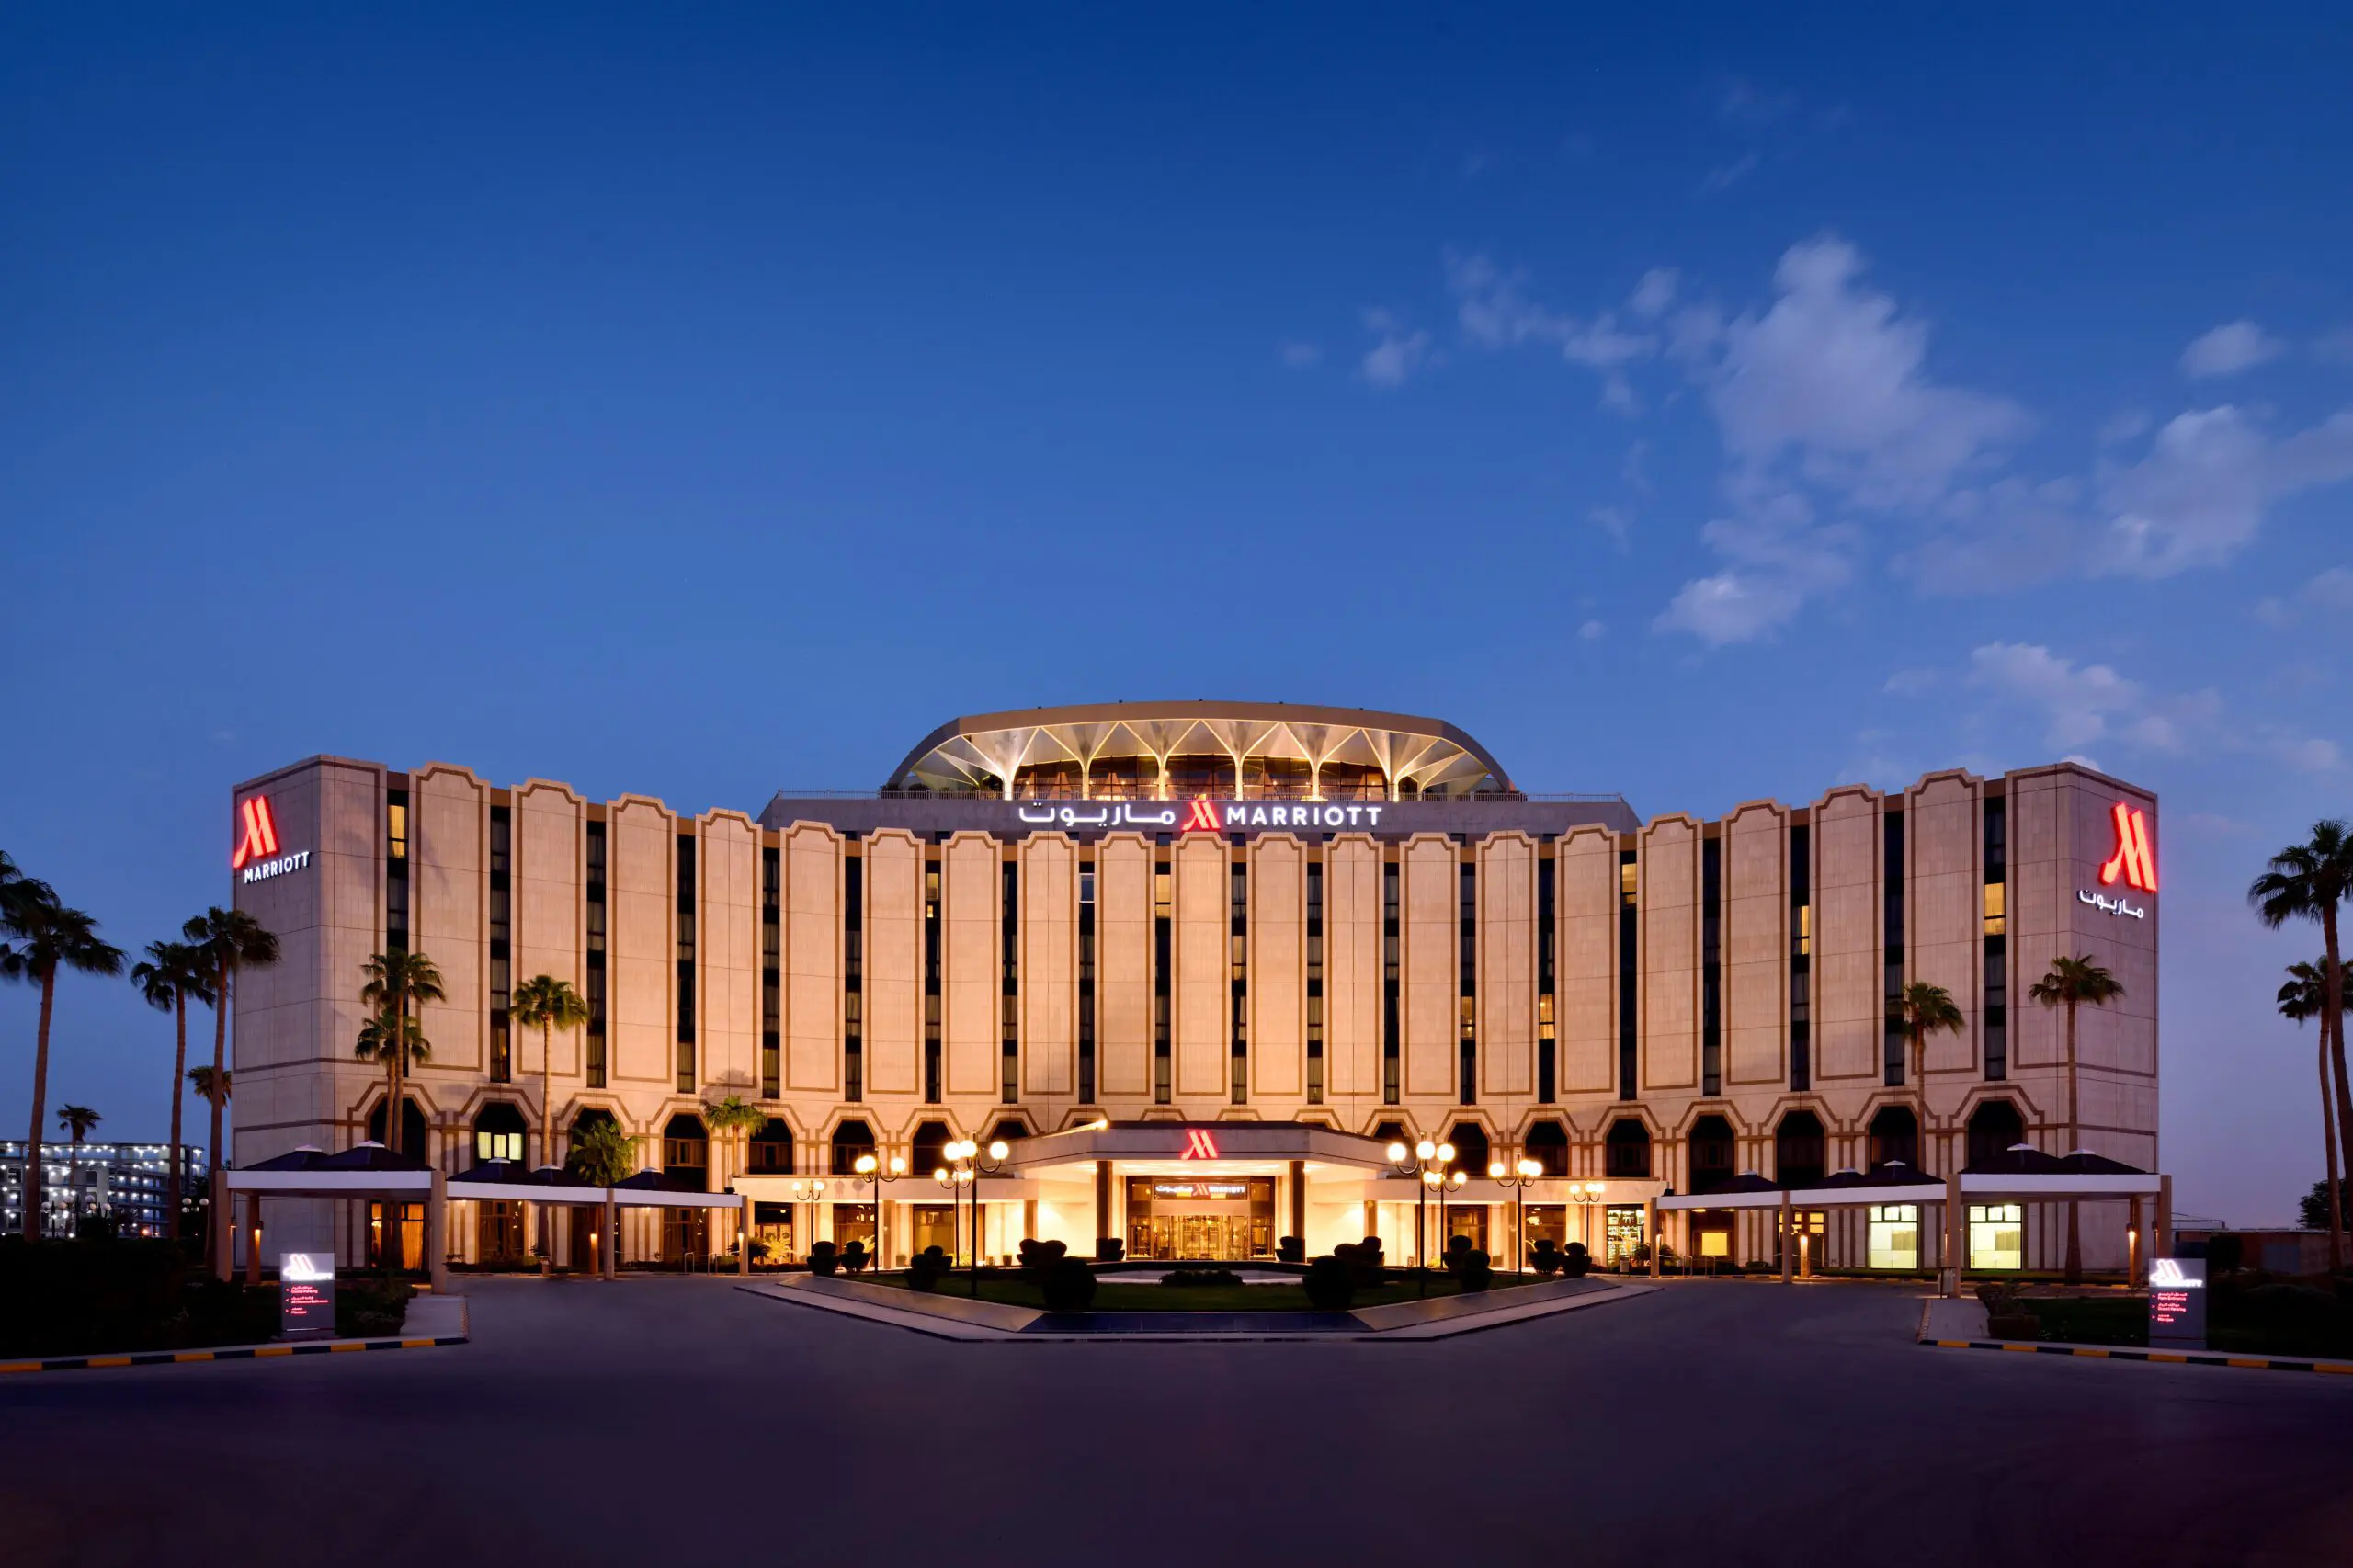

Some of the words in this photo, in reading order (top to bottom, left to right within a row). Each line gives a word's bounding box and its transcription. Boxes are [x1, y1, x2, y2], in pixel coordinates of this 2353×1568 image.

[1018, 802, 1176, 827] ماريوت
[1226, 806, 1382, 826] MARRIOTT
[244, 851, 310, 884] MARRIOTT
[2079, 889, 2143, 919] ماريوت
